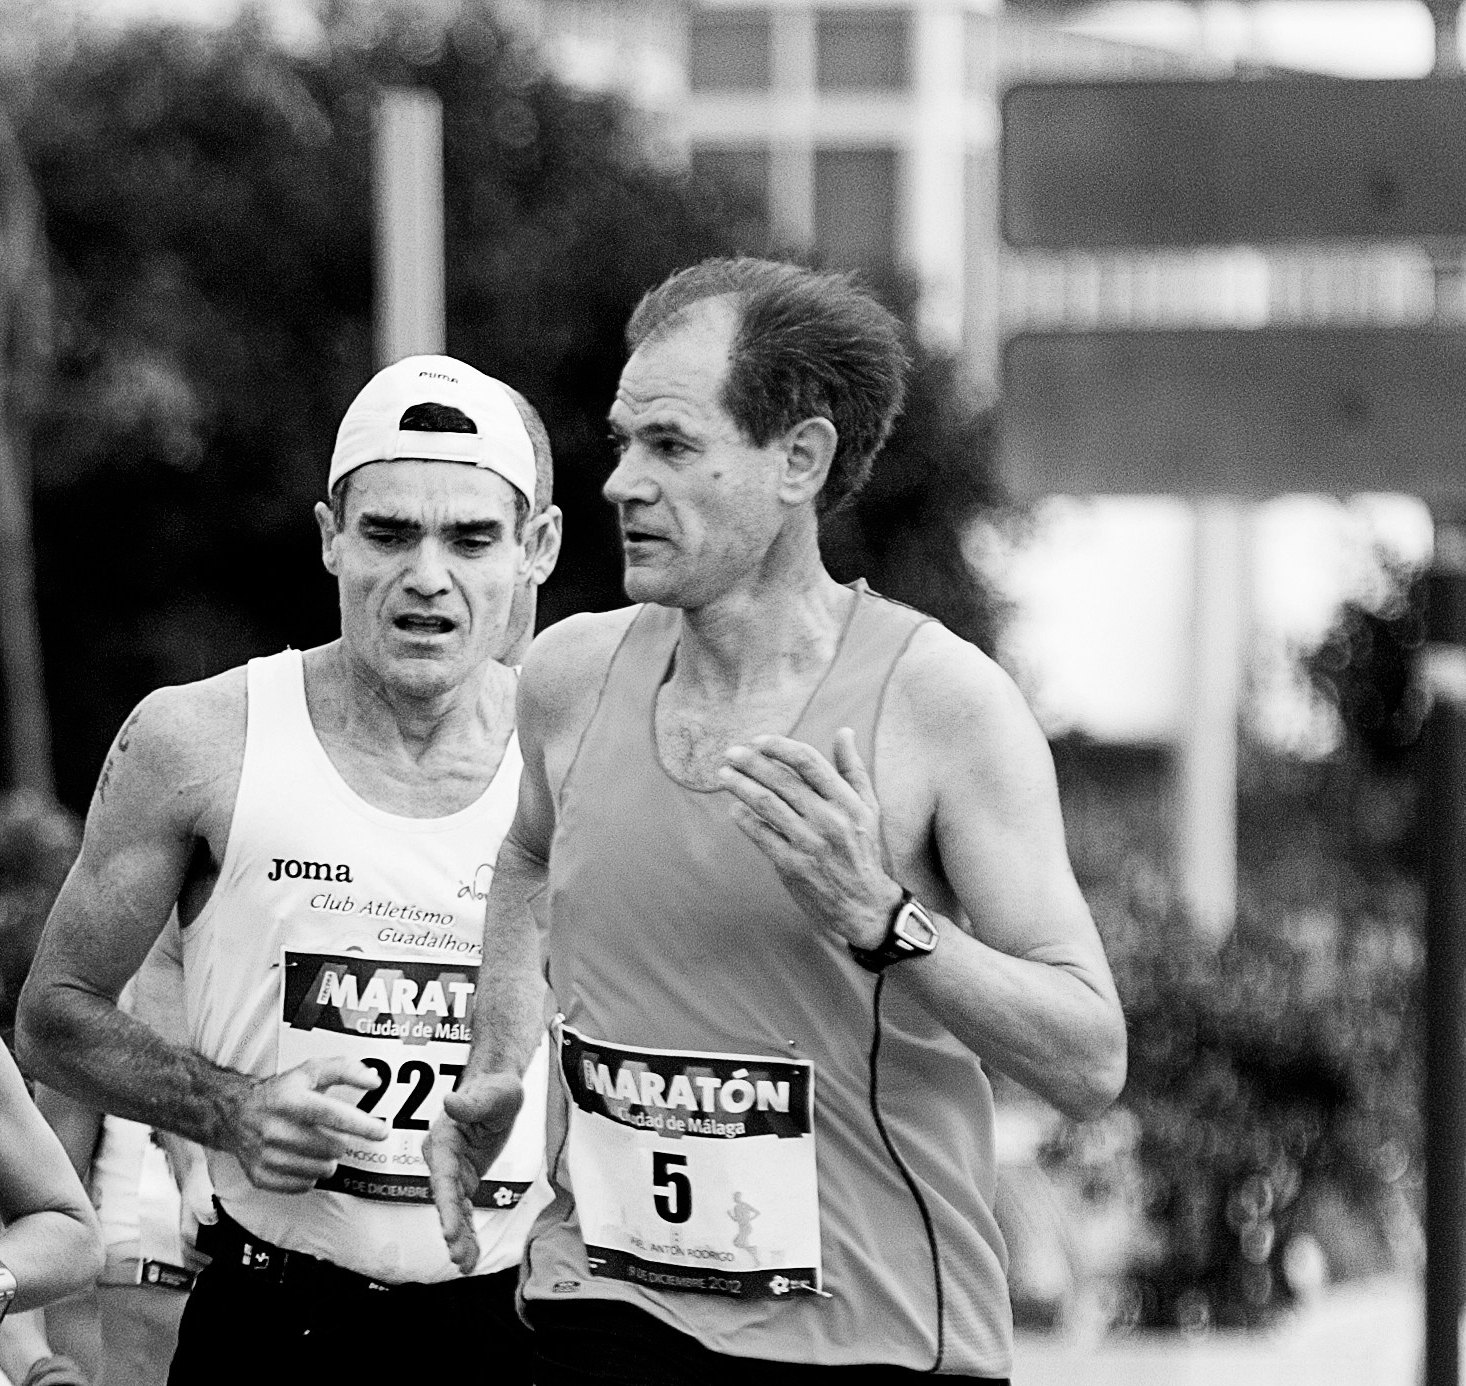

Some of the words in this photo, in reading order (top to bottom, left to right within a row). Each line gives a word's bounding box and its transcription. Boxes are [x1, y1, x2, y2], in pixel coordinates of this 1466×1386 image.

[267, 858, 354, 883] Joma
[310, 894, 354, 912] Club
[377, 927, 483, 955] Guadalhor
[316, 970, 476, 1018] MARAT
[356, 1018, 410, 1037] Ciudad
[412, 1020, 433, 1038] de
[435, 1023, 472, 1041] Mála
[583, 1060, 790, 1113] MARATÓN
[667, 1115, 685, 1132] de
[688, 1116, 746, 1138] Málaga
[368, 1184, 429, 1199] DICIEMBRE
[652, 1151, 692, 1224] 5
[707, 1276, 742, 1293] 2012
